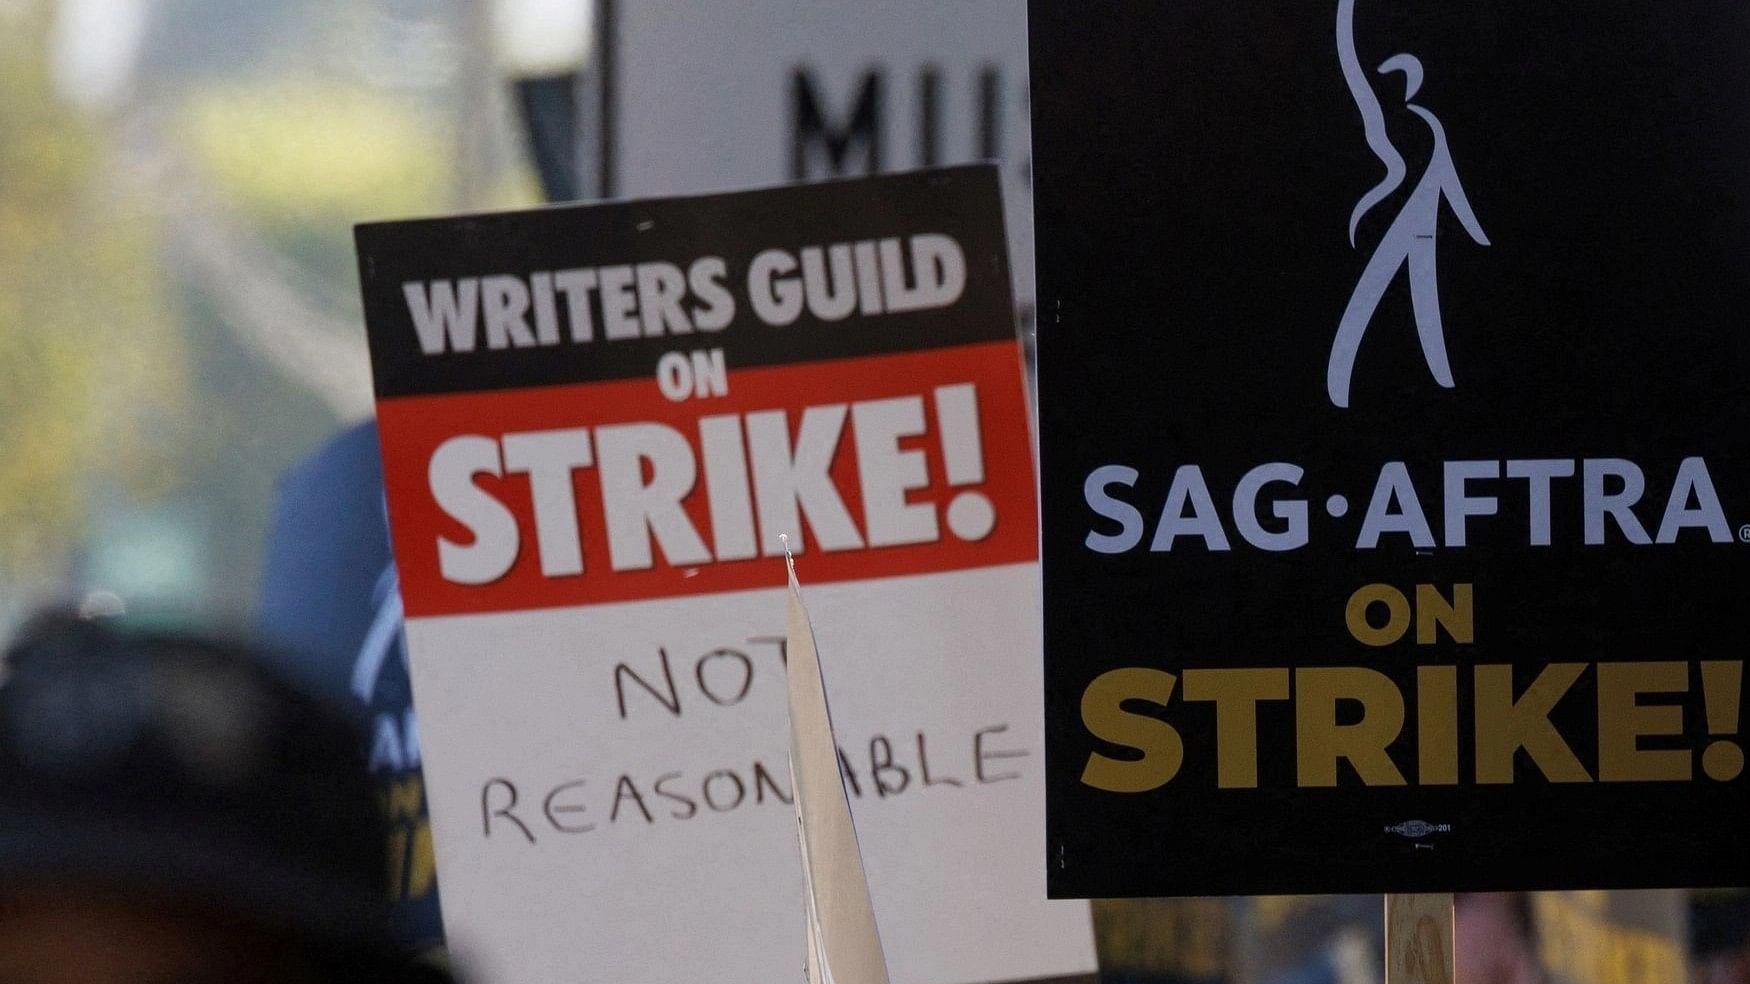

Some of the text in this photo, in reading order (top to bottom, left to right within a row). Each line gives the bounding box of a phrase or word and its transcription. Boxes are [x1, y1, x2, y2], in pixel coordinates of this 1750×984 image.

[402, 233, 967, 355] WRITERS GUILD
[656, 349, 729, 401] ON
[427, 383, 997, 587] STRIKE!
[1345, 582, 1475, 647] ON
[1079, 659, 1746, 794] STRIKE!
